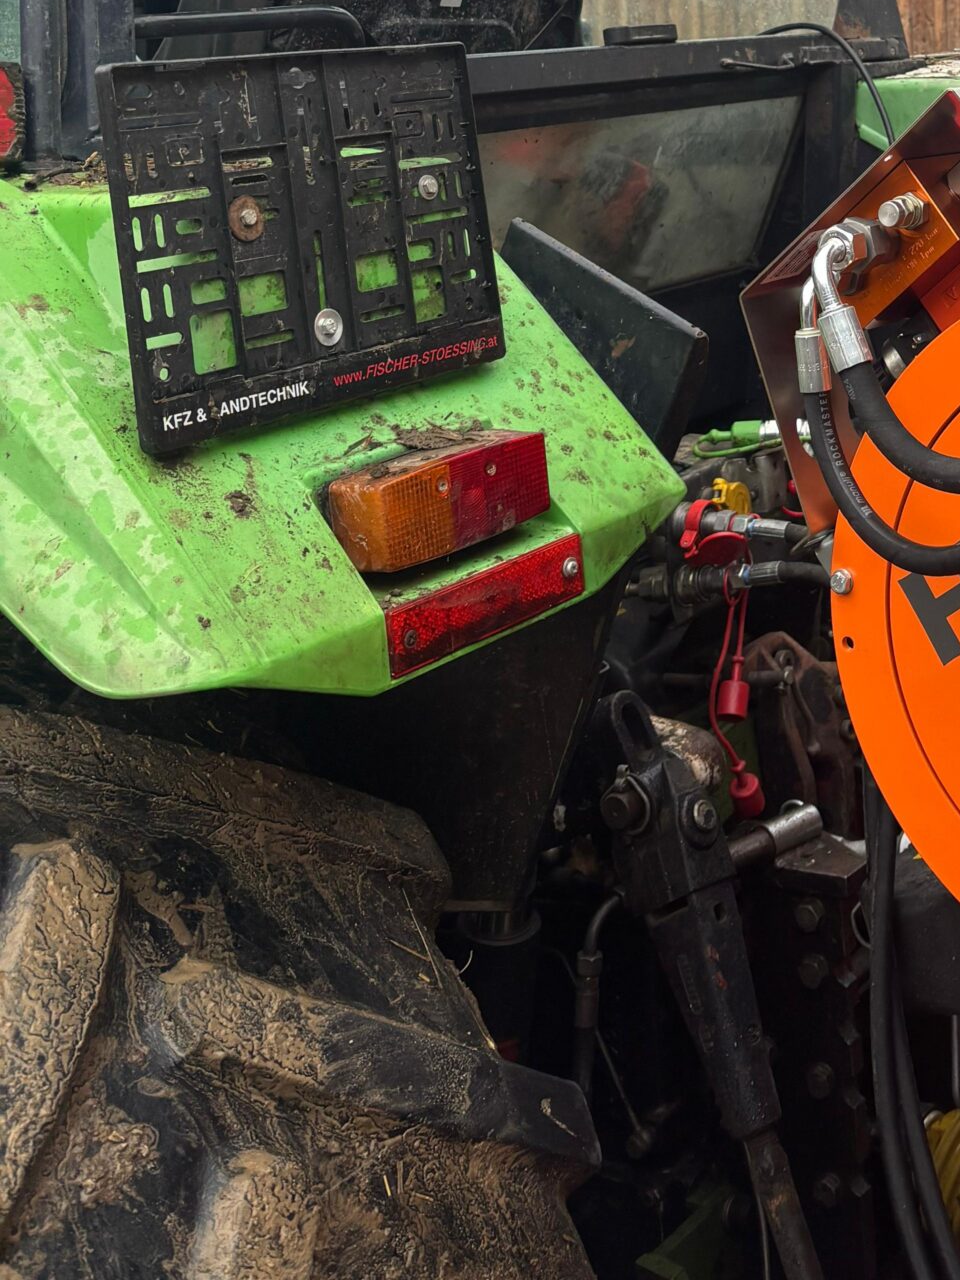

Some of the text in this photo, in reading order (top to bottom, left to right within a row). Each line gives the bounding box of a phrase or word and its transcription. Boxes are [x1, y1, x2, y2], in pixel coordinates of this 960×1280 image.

[333, 335, 498, 386] www.FISCHER-STOESSING.at
[163, 381, 310, 431] KFZ & ANDTECHNIK
